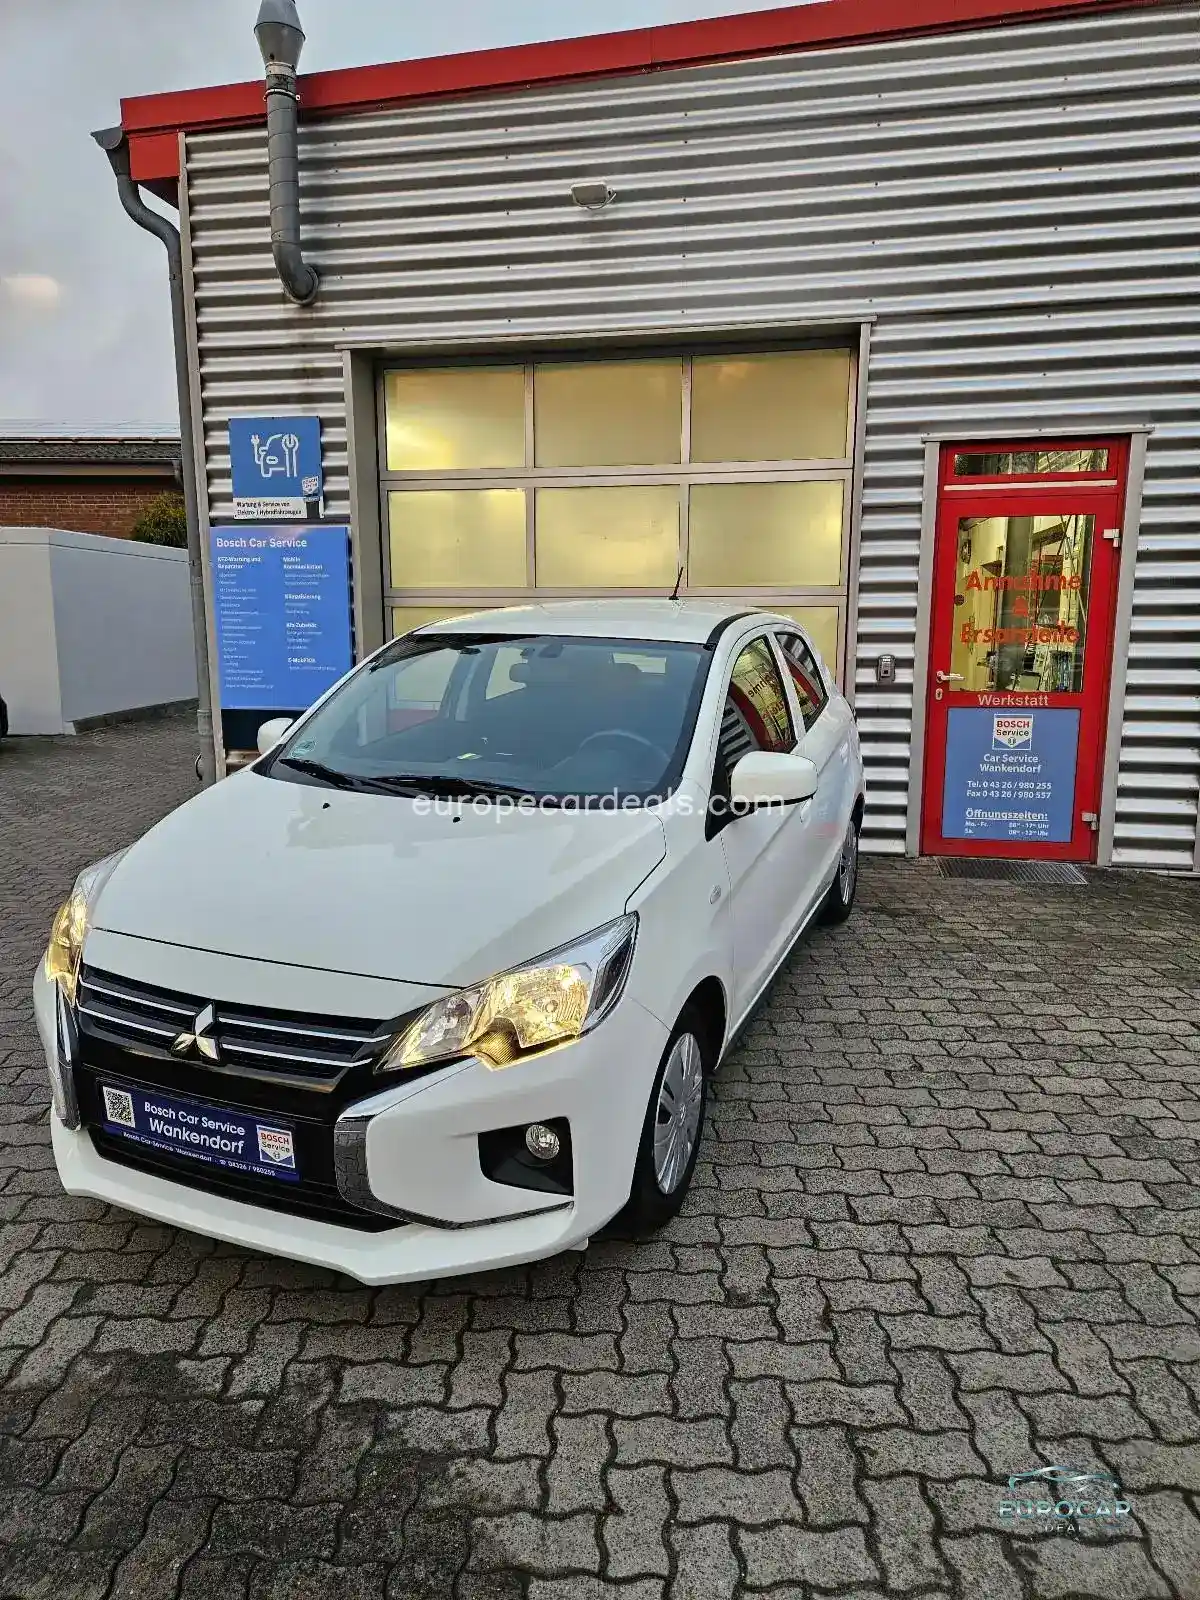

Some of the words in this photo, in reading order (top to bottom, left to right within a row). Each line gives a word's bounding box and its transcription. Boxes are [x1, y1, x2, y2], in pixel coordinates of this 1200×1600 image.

[216, 537, 247, 548] Bosch
[249, 537, 267, 548] Car
[269, 538, 308, 548] Service
[960, 621, 1081, 644] Ersateile
[977, 694, 1049, 707] Werkstatt
[996, 720, 1030, 729] BOSCH
[996, 729, 1030, 737] Service
[983, 753, 1001, 763] Car
[1002, 754, 1039, 763] Service
[979, 764, 1043, 774] Wankendorf
[967, 780, 982, 788] Tel.
[989, 781, 1001, 789] 43
[1001, 781, 1013, 789] 26
[1018, 782, 1035, 790] 980
[1036, 782, 1052, 790] 255
[966, 789, 981, 797] Fax
[989, 790, 1000, 798] 43
[1001, 790, 1012, 798] 26
[1018, 791, 1034, 799] 980
[965, 807, 1049, 820] Öffnungszeiten:
[144, 1101, 176, 1120] Bosch
[178, 1111, 200, 1125] Car
[201, 1116, 246, 1136] Service
[149, 1117, 246, 1154] Wankendorf
[260, 1132, 290, 1145] BOSCH
[261, 1141, 291, 1153] Service
